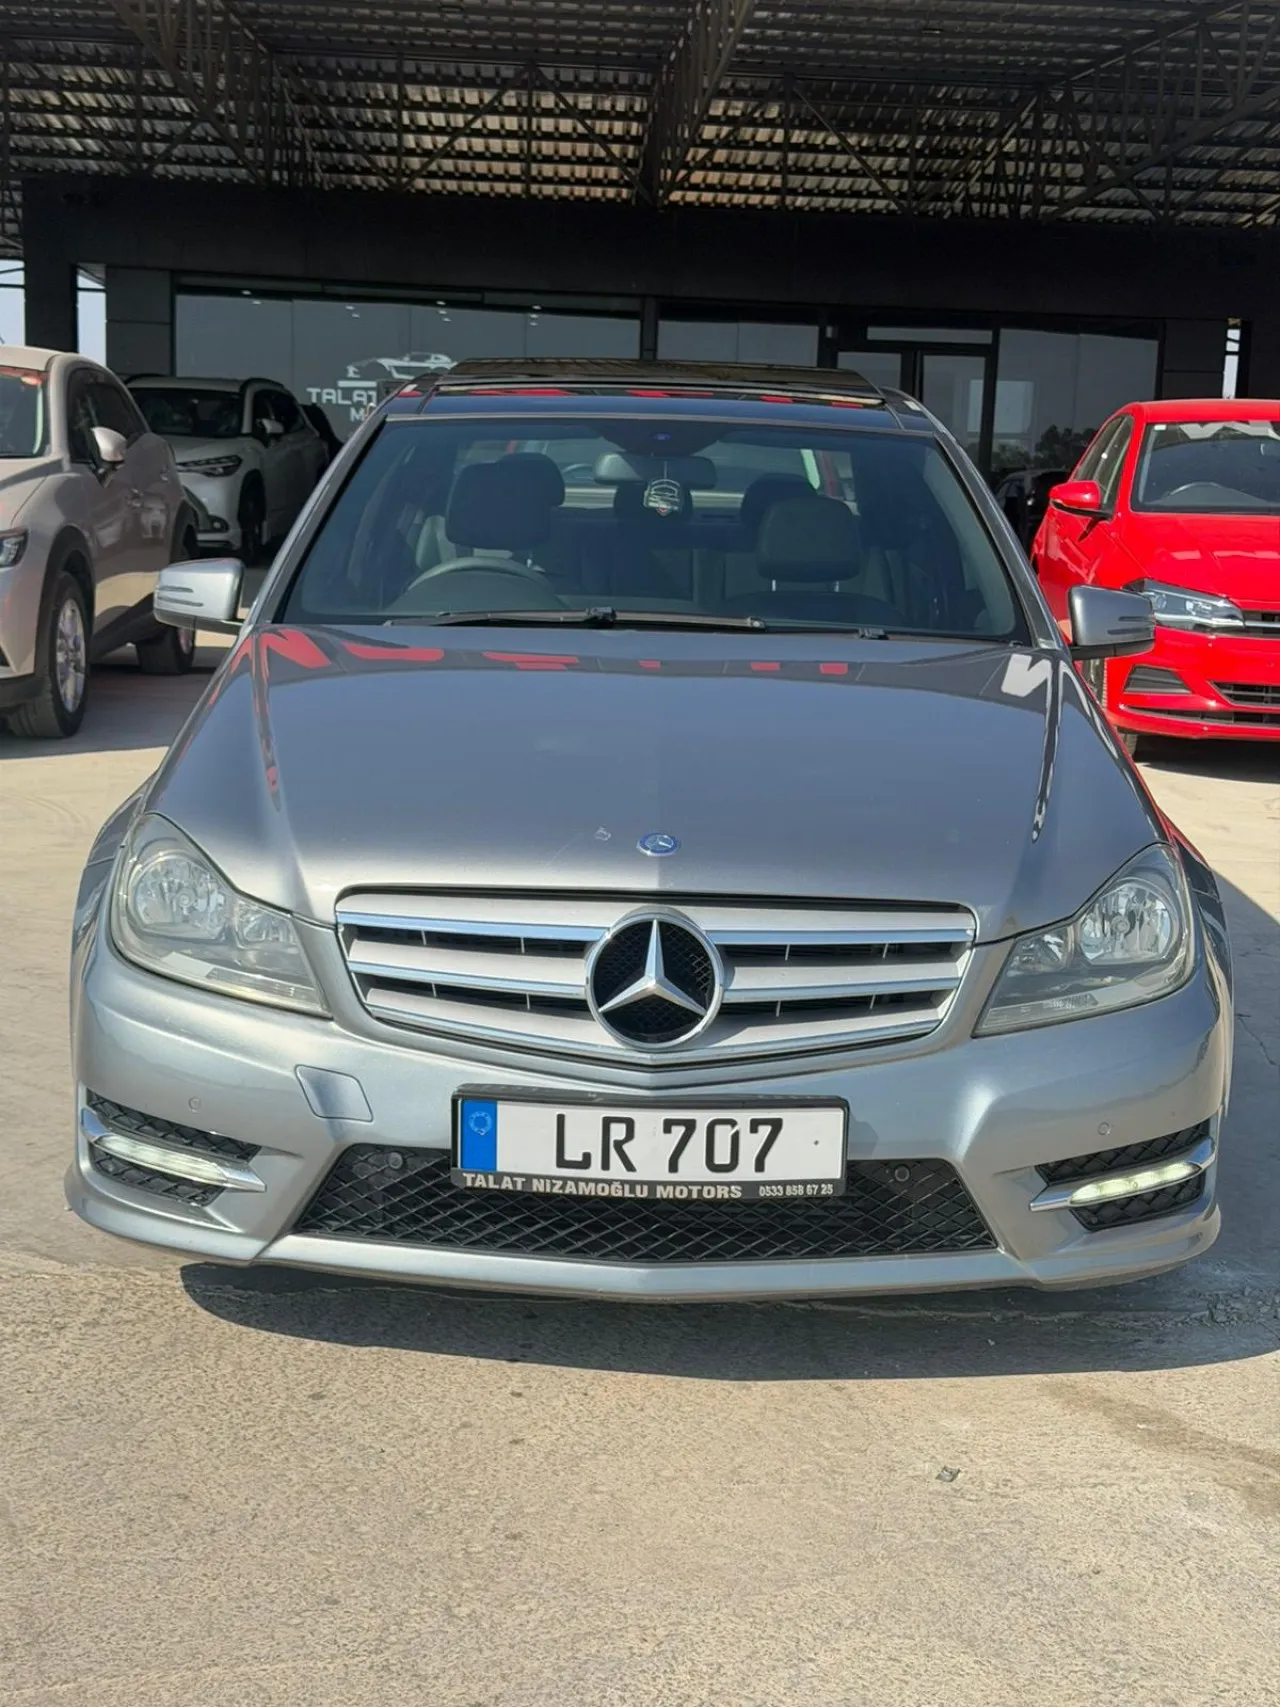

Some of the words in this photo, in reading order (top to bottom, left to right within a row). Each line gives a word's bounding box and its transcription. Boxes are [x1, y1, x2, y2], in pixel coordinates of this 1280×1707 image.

[556, 1113, 637, 1172] LR
[662, 1117, 783, 1173] 707
[462, 1172, 526, 1191] TALAT
[656, 1184, 742, 1199] MOTORS
[759, 1185, 784, 1197] 0533
[806, 1183, 819, 1195] 67
[821, 1183, 834, 1194] 25
